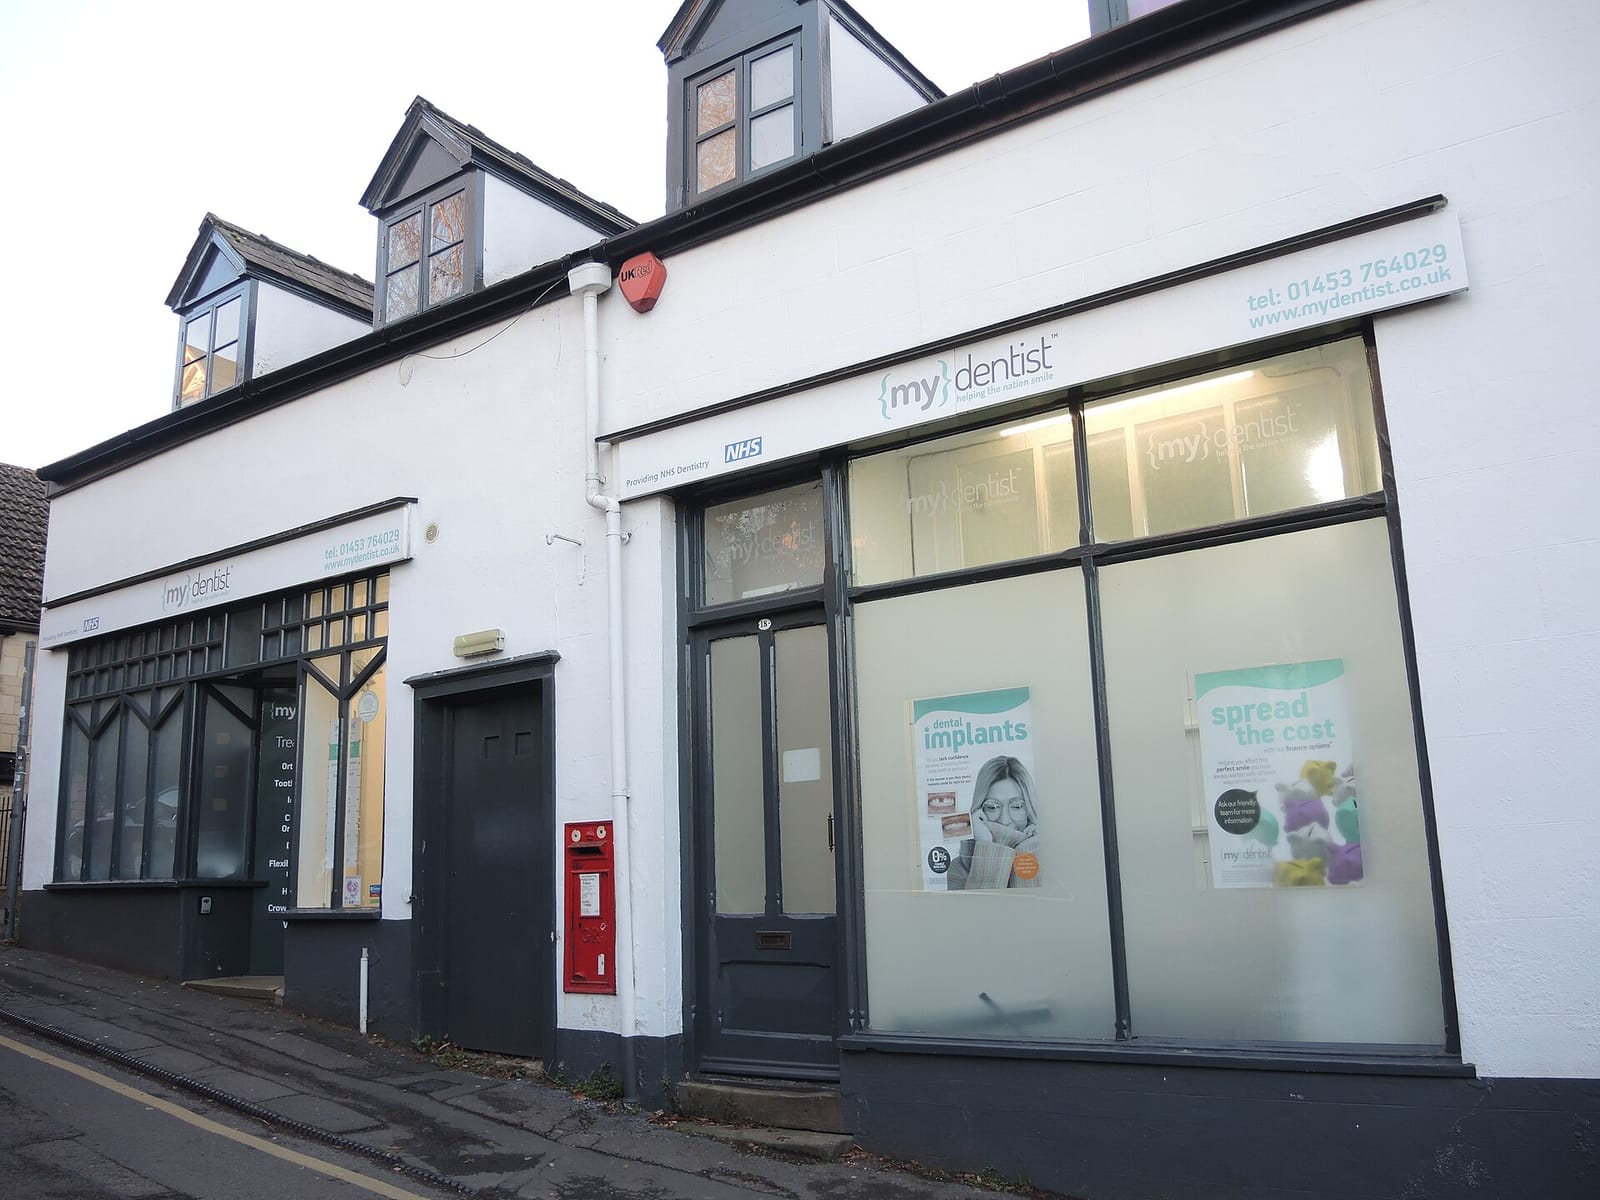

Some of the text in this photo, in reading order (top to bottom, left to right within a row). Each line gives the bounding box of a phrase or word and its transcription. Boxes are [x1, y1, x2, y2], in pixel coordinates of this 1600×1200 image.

[621, 260, 653, 282] UKRed
[1247, 244, 1447, 311] tel: 01453 764029
[1249, 266, 1451, 329] www.mydentist.co.uk
[956, 373, 1054, 403] helping the nation smile
[725, 438, 761, 462] NHS
[626, 460, 710, 488] Providing NHS Dentistry
[324, 543, 400, 571] www.mydentist.co.uk
[325, 529, 400, 560] tel: 01453 764029
[83, 617, 99, 632] NHS
[933, 717, 963, 729] dental
[1211, 691, 1310, 732] spread
[924, 720, 1028, 753] implants
[1235, 719, 1336, 746] the cost
